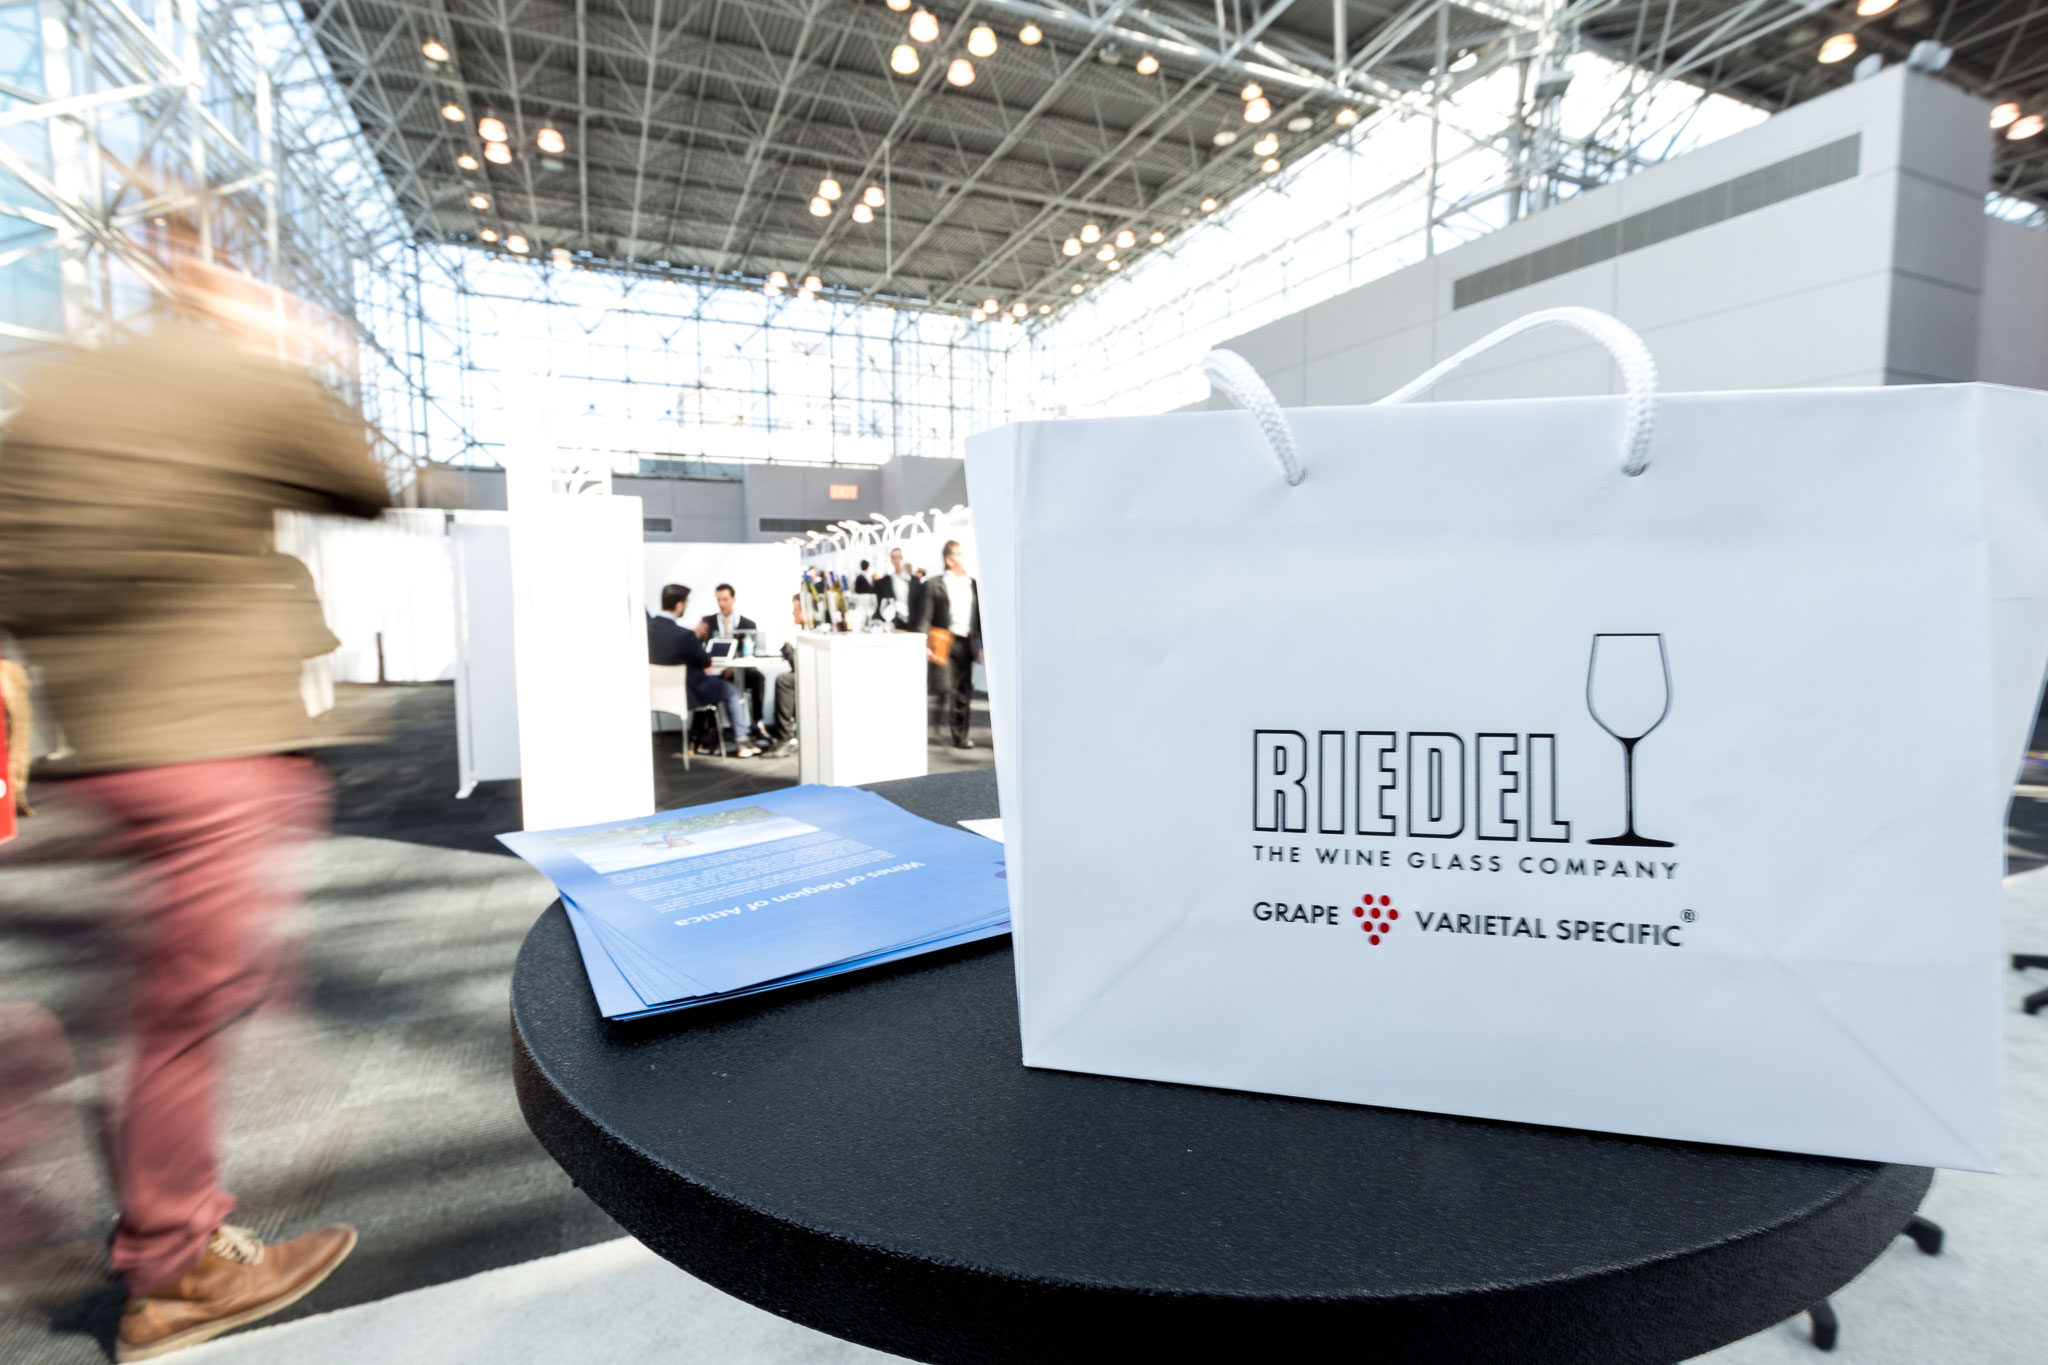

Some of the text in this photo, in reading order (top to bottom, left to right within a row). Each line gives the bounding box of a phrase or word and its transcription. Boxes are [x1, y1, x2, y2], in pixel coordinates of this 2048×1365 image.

[1252, 728, 1572, 844] RIEDEL
[1252, 845, 1680, 880] THE WINE GLASS COMPANY
[674, 861, 926, 926] Wines of Region of Attica
[1252, 901, 1340, 926] GRAPE
[1414, 911, 1549, 940] VARIETAL
